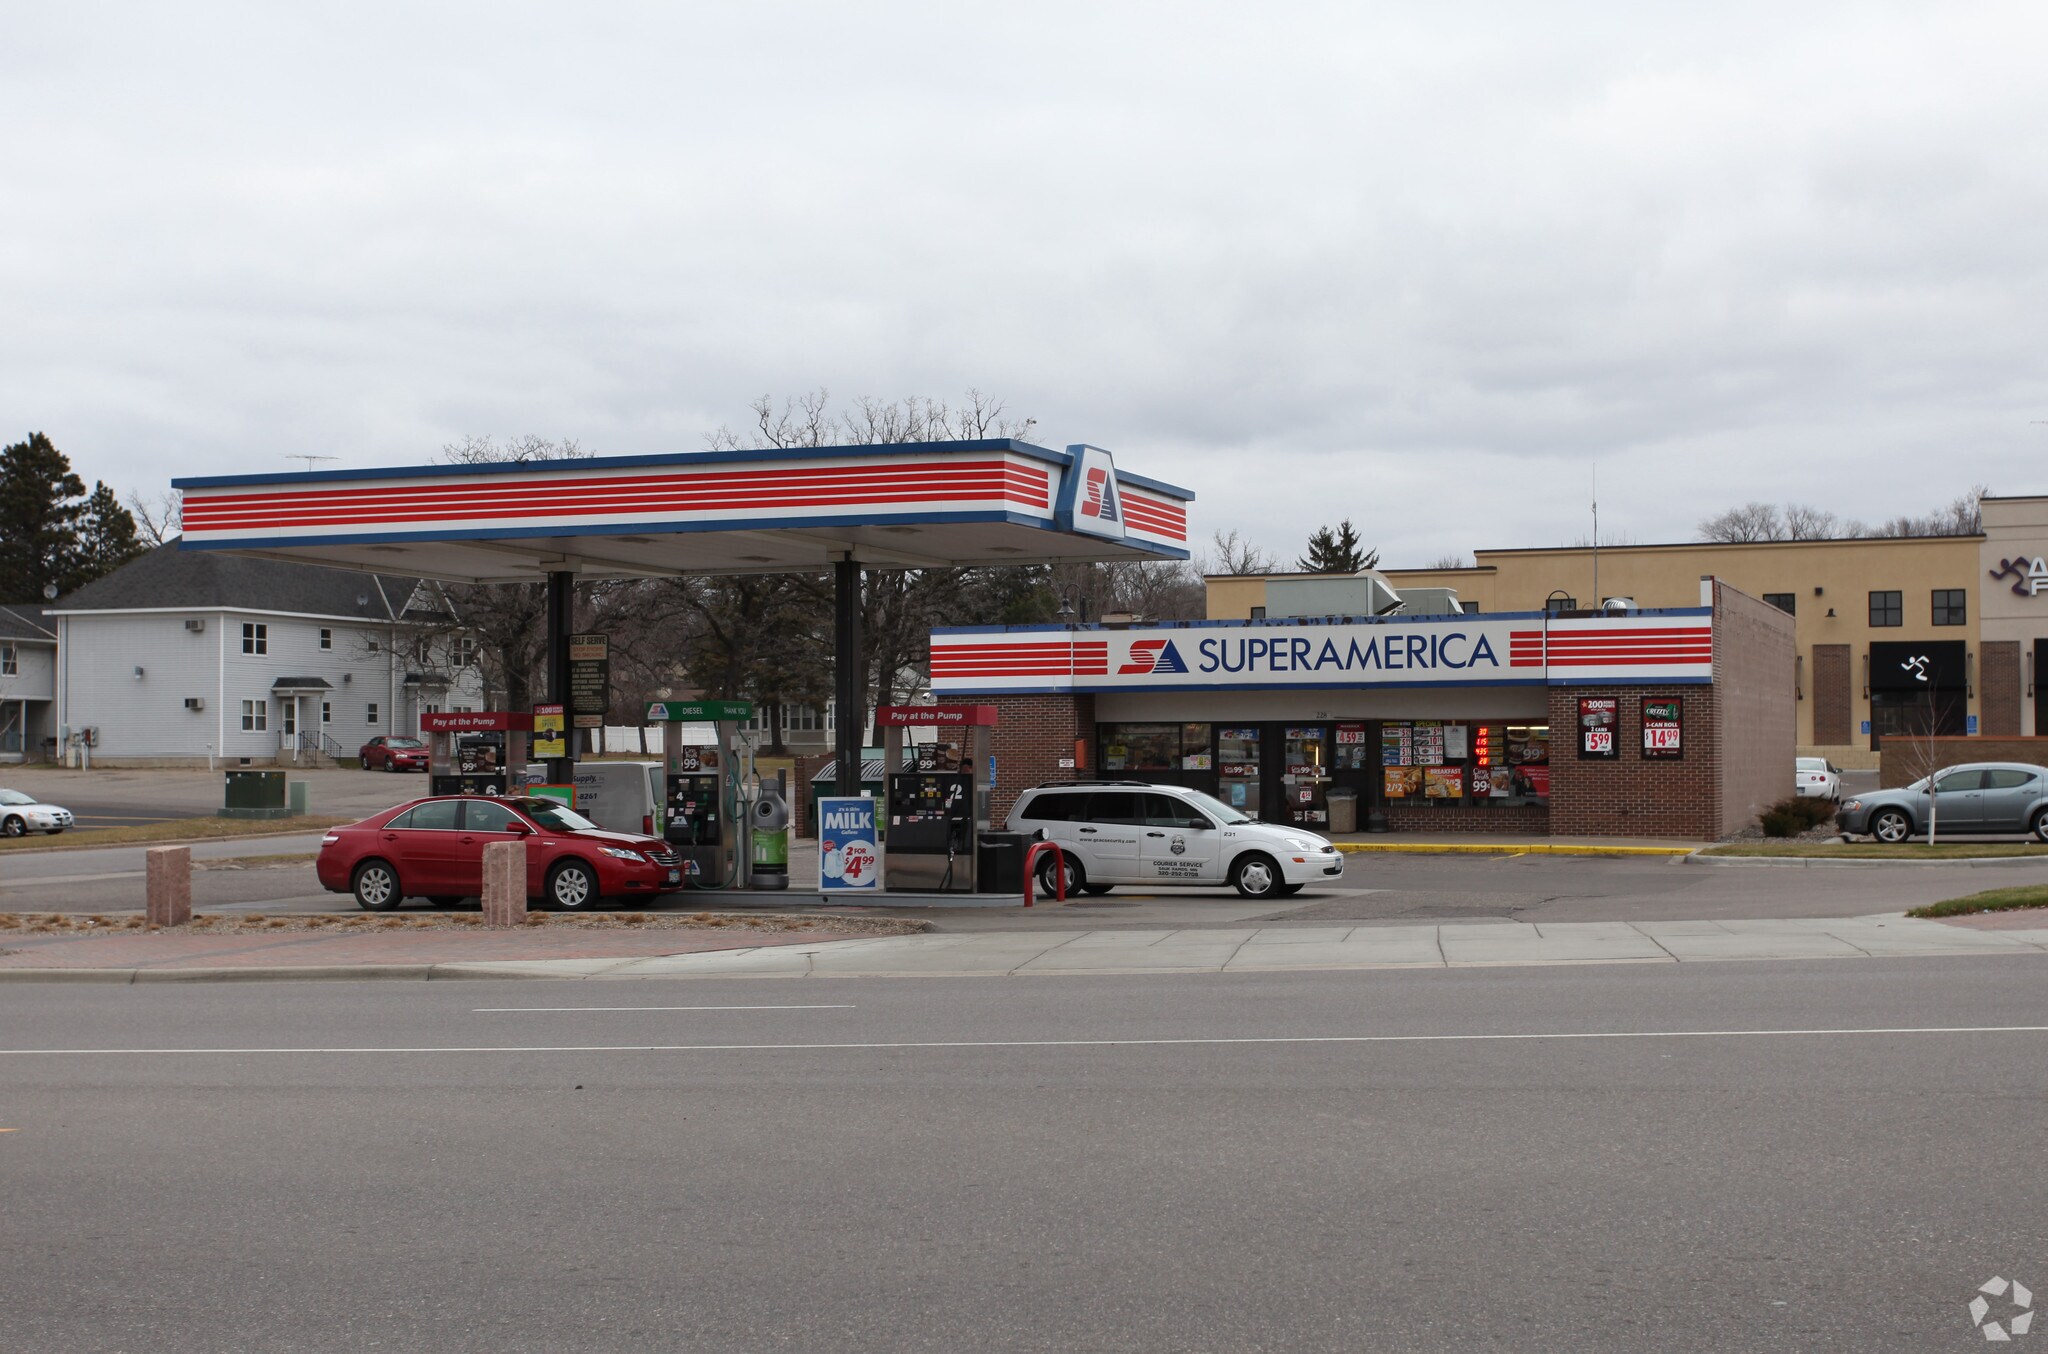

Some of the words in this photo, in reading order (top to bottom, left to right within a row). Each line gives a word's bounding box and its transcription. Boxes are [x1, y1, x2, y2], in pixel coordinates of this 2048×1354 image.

[571, 636, 586, 645] SELF
[586, 636, 606, 645] SERVE
[1199, 632, 1499, 673] SUPERAMERICA
[1588, 700, 1603, 709] 200
[682, 707, 703, 715] DIESEL
[737, 707, 746, 715] YOU
[891, 712, 907, 721] Pay
[909, 712, 918, 720] at
[920, 712, 935, 720] the
[937, 711, 963, 720] Pump
[432, 718, 447, 727] Pay
[472, 718, 495, 726] Pump
[462, 762, 477, 771] 99¢
[919, 759, 936, 769] 99¢
[1472, 780, 1490, 792] 99¢
[676, 791, 683, 801] 4
[950, 783, 963, 800] 2
[825, 812, 872, 829] MILK
[846, 846, 854, 856] 2
